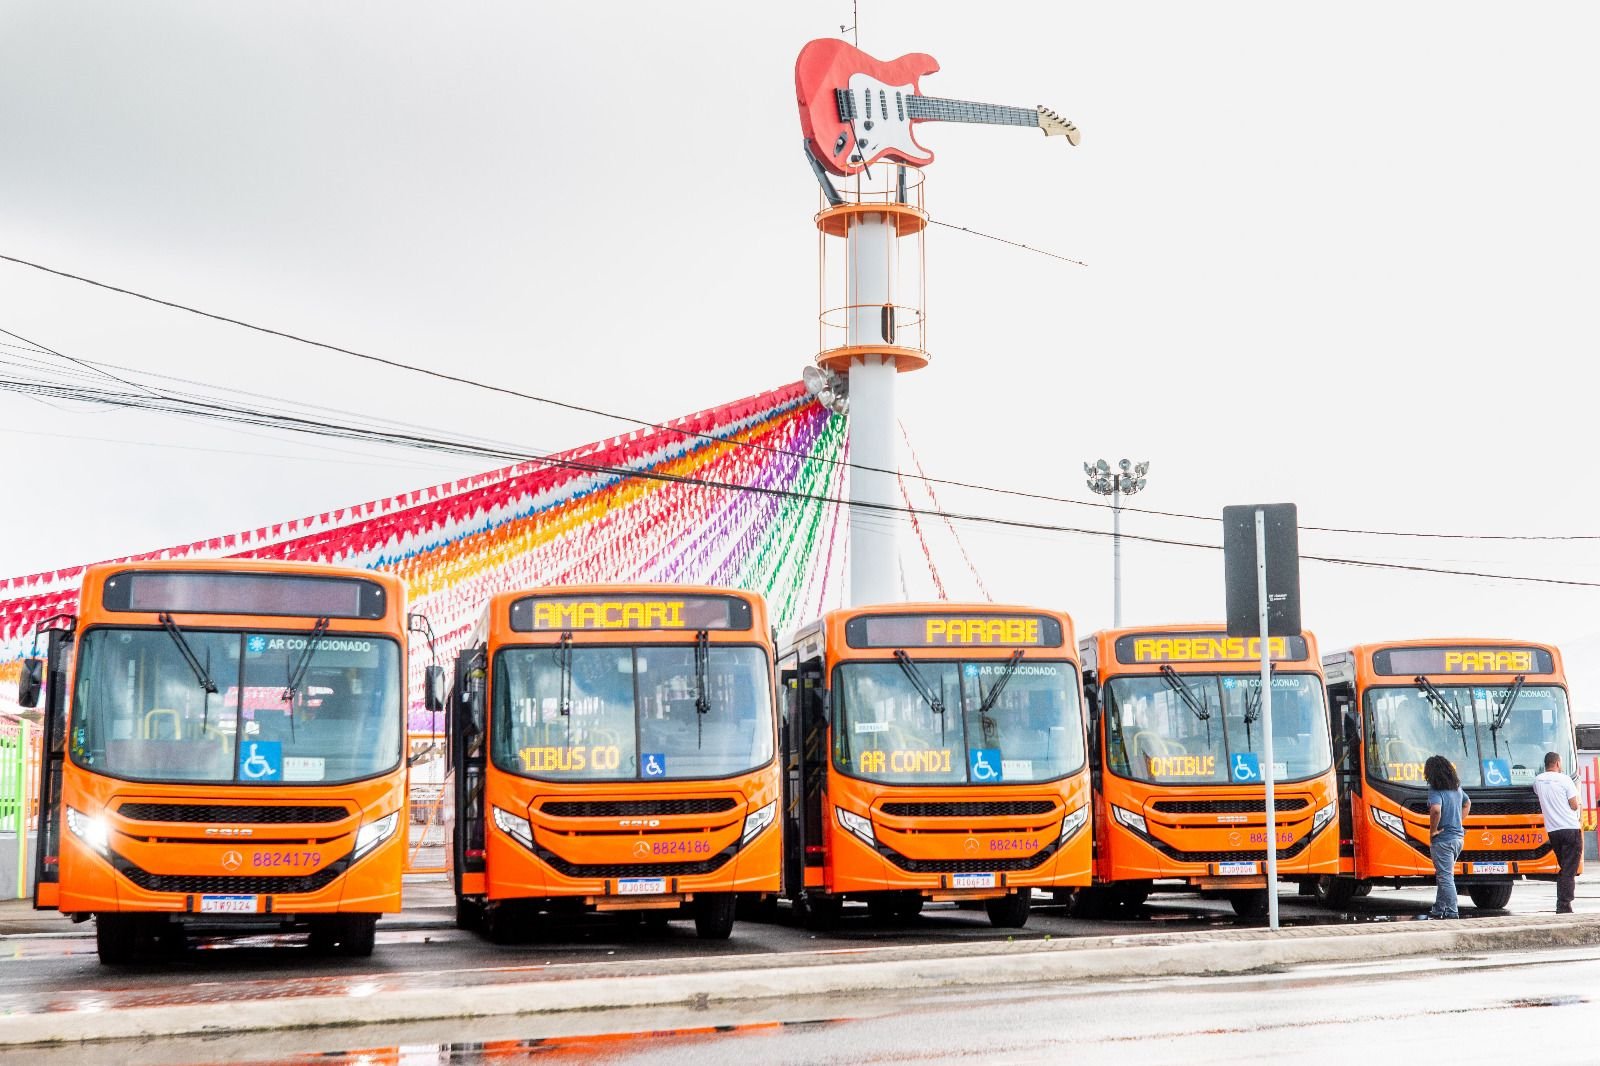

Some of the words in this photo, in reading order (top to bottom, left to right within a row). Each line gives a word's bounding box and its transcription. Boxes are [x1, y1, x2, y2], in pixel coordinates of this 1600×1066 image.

[534, 601, 684, 628] AMACARI
[926, 619, 1038, 643] PARABE
[268, 639, 285, 650] AR
[1135, 637, 1244, 661] RABENS
[1248, 637, 1287, 658] CA
[1445, 652, 1532, 671] PARAB
[980, 667, 993, 675] AR
[1499, 690, 1551, 698] COCIONADO
[591, 746, 619, 770] CO
[860, 751, 886, 773] AR
[891, 750, 951, 773] CONDI
[990, 839, 1039, 851] 8824164
[1250, 832, 1294, 844] 882168
[1501, 833, 1543, 845] 8824178
[653, 840, 710, 855] 8824186
[253, 852, 320, 867] 8824179
